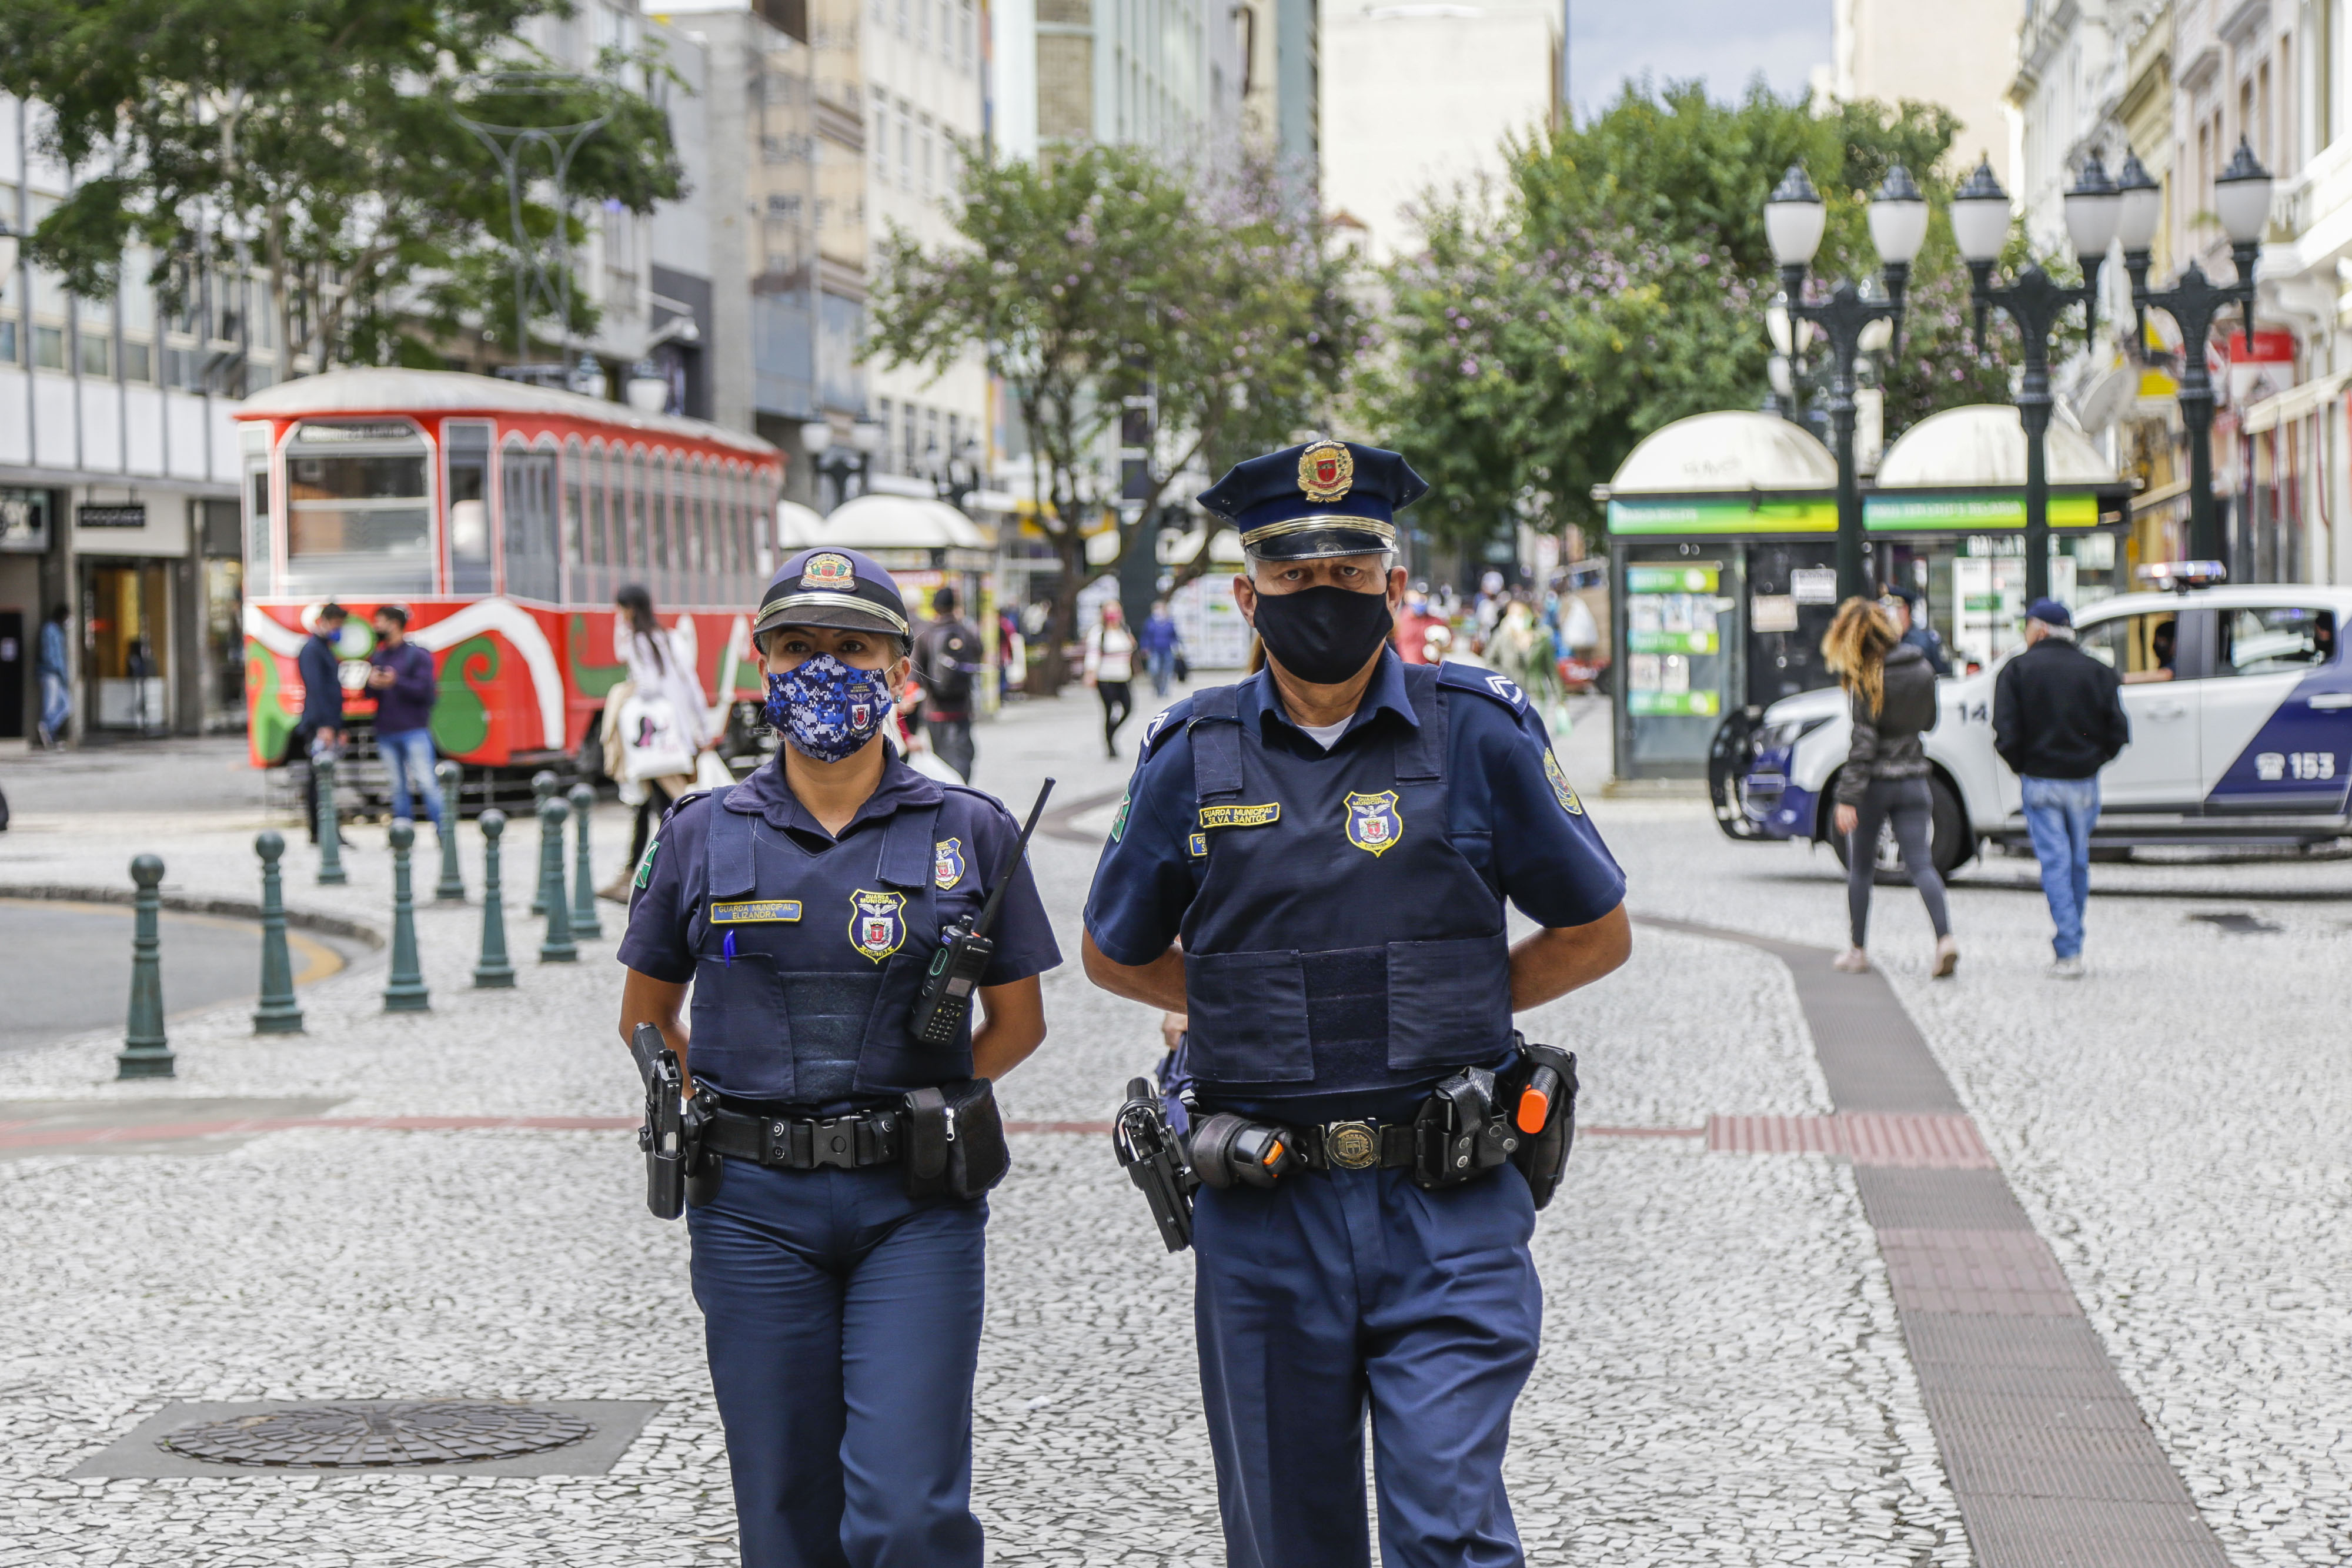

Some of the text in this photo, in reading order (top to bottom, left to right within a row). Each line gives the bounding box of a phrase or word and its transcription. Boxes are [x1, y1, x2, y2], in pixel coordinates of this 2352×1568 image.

[2288, 752, 2335, 780] 153
[1204, 807, 1273, 818] GUARDA MUNICIPAL
[1208, 814, 1267, 824] SILVA SANTOS
[732, 911, 777, 920] ELIZANDRA
[864, 948, 891, 957] CURITIBA
